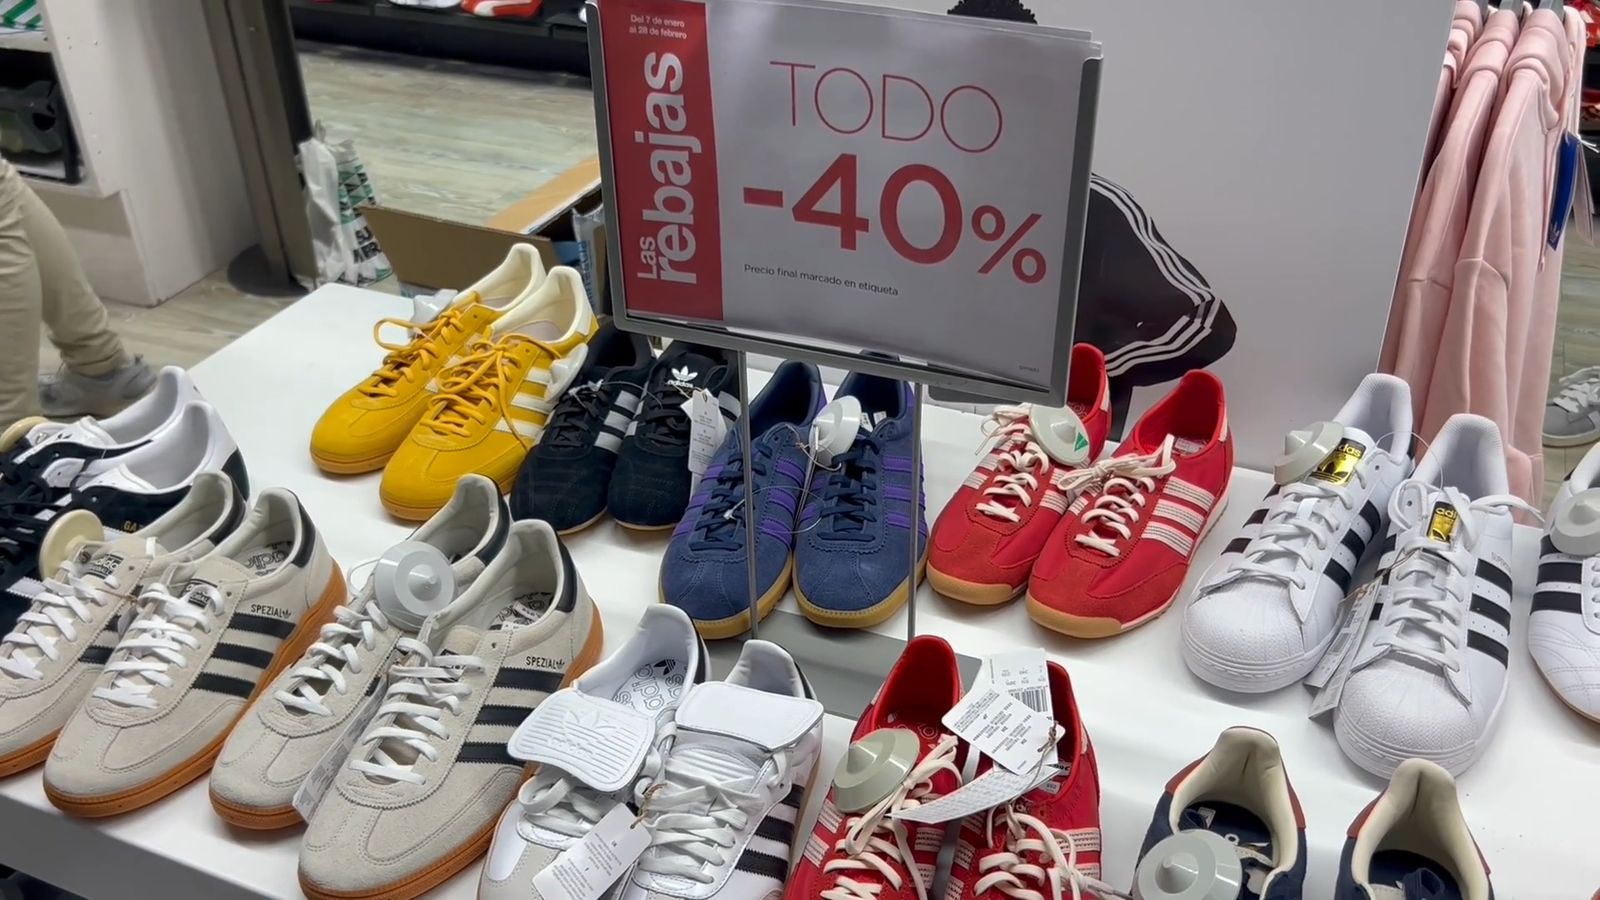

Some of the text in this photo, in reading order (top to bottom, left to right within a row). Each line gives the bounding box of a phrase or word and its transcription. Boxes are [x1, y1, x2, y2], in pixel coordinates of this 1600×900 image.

[629, 25, 688, 39] al 28 de febrero
[630, 14, 644, 23] Del
[652, 17, 662, 25] de
[663, 19, 685, 28] enero
[770, 61, 1003, 153] TODO
[634, 51, 702, 285] rebajas
[743, 152, 1047, 284] -40%
[637, 237, 656, 280] Las
[744, 263, 899, 296] Precio final marcado en etiqueta
[1435, 507, 1457, 520] adi
[250, 603, 282, 618] SPEZIAL
[525, 655, 557, 670] SPEZIAL
